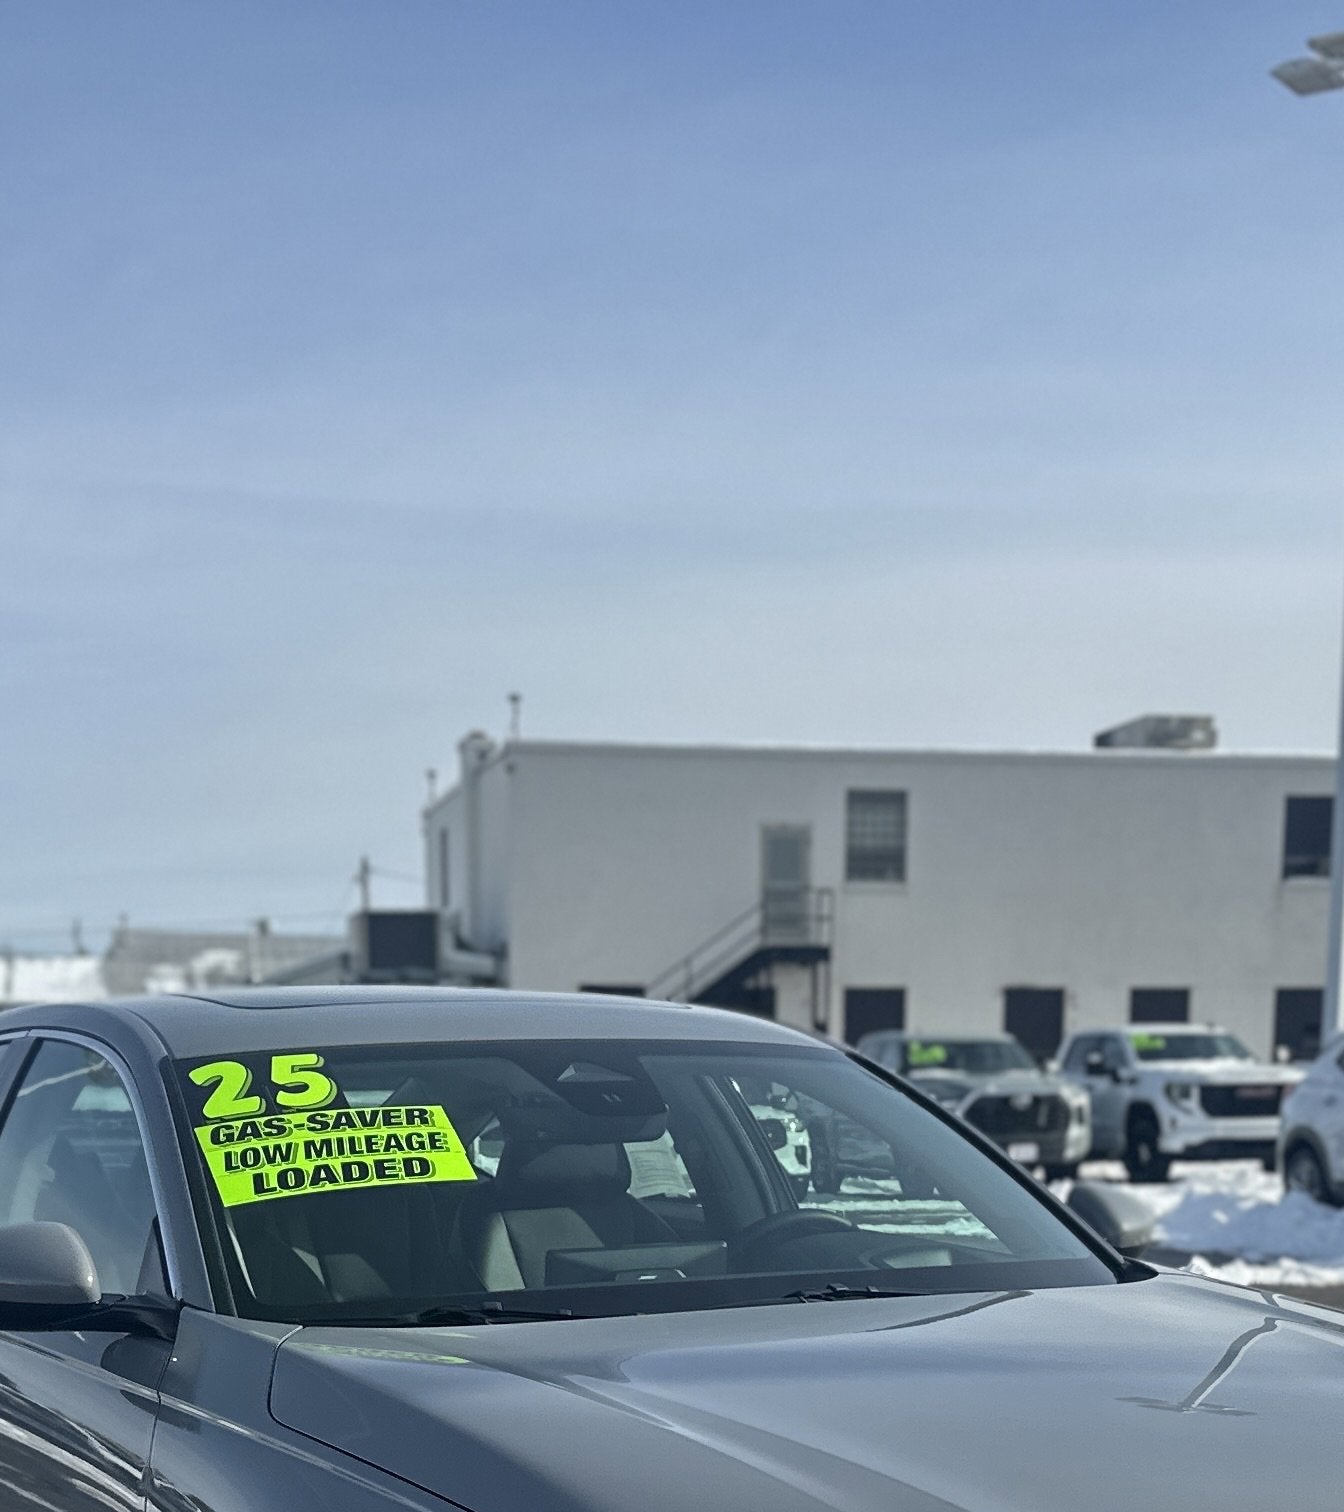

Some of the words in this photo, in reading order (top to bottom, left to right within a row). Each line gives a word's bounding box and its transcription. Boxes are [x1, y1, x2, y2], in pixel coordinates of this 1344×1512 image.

[188, 1053, 336, 1119] 25
[210, 1108, 433, 1146] GAS-SAVER
[224, 1141, 297, 1173] LOW
[303, 1132, 449, 1161] MILEAGE
[252, 1157, 434, 1195] LOADED
